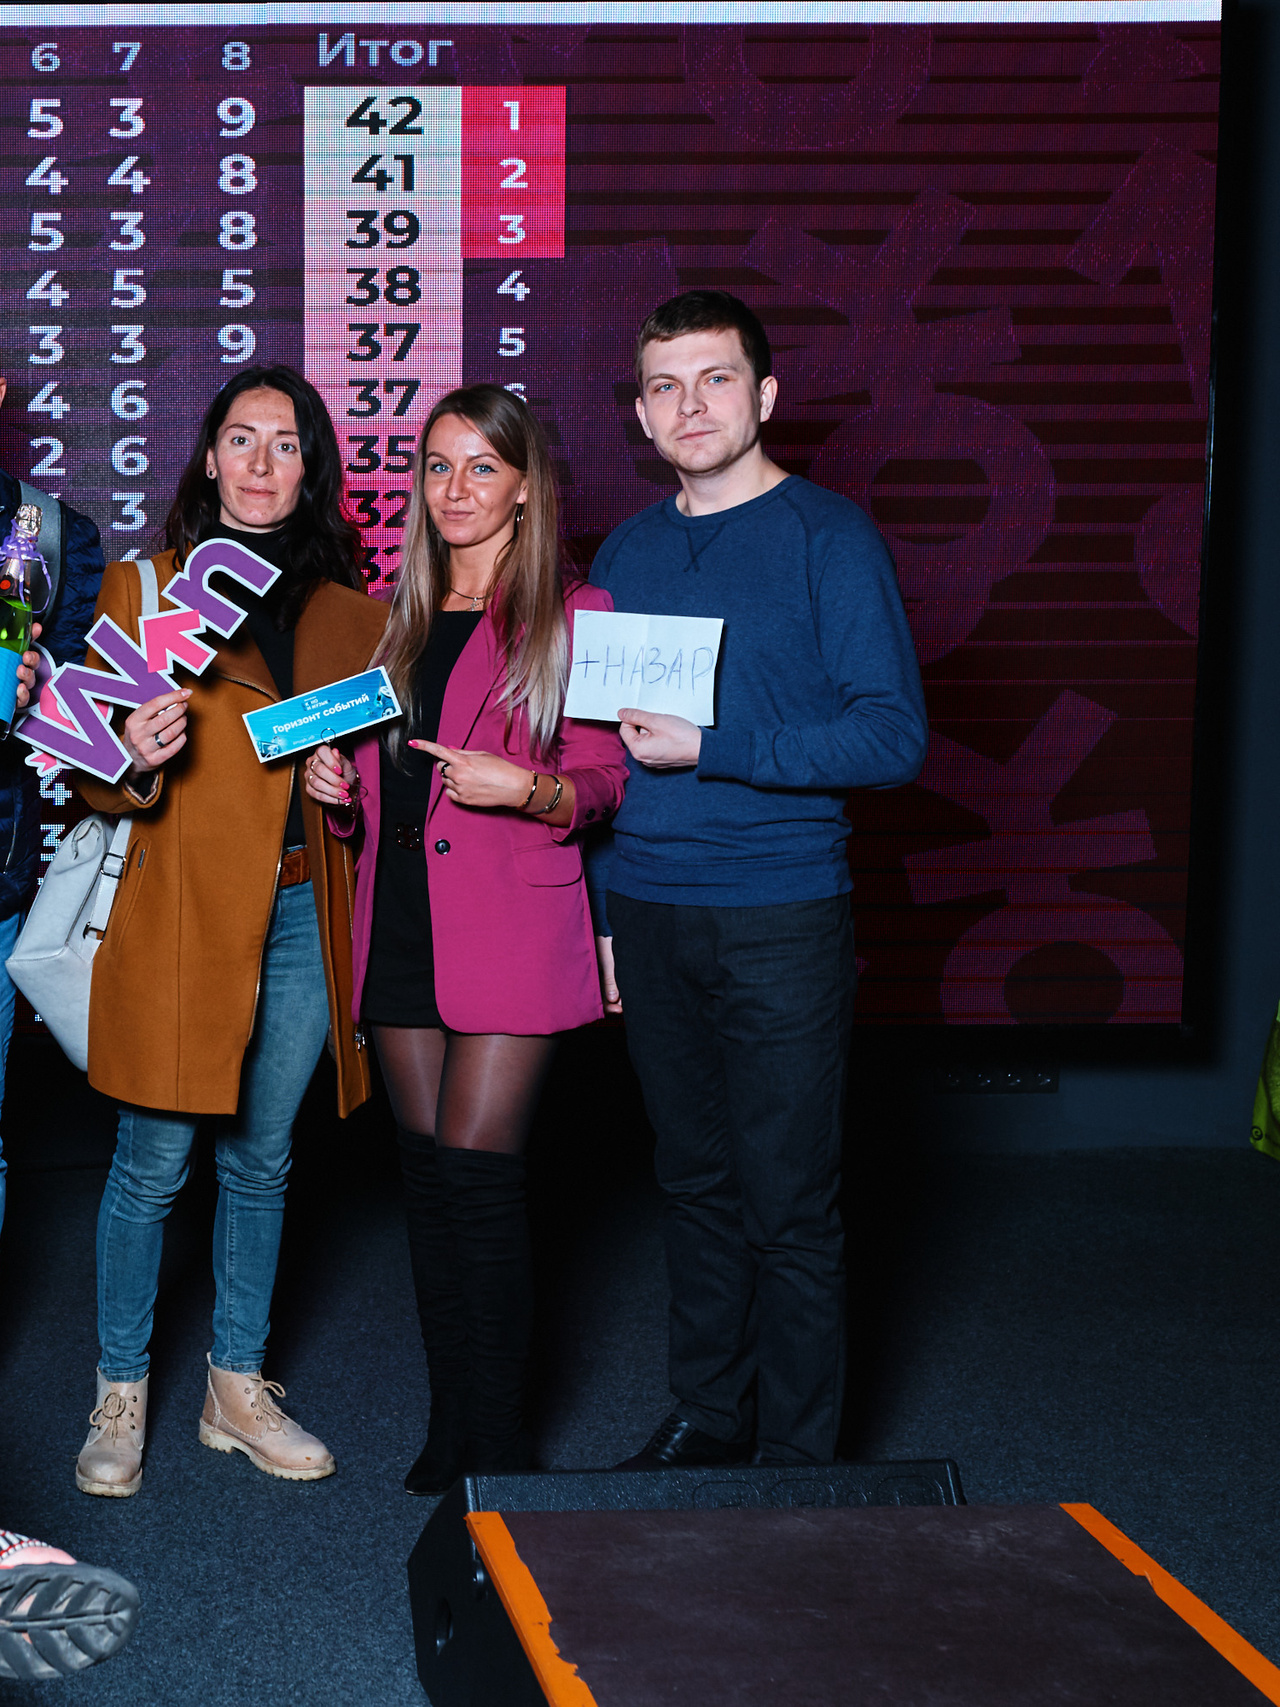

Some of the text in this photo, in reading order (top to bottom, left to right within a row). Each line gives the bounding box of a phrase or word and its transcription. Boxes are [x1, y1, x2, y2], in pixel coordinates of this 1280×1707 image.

[31, 42, 61, 72] 6
[113, 41, 142, 71] 7
[221, 41, 251, 71] 8
[319, 32, 453, 66] Итог
[27, 98, 64, 138] 5
[109, 98, 145, 138] 3
[216, 97, 256, 137] 9
[346, 95, 425, 136] 42
[503, 100, 520, 131] 1
[25, 156, 69, 194] 4
[107, 155, 151, 194] 4
[219, 154, 258, 195] 8
[351, 153, 415, 193] 41
[499, 158, 529, 189] 2
[28, 212, 65, 252] 5
[109, 211, 146, 251] 3
[219, 211, 257, 251] 8
[346, 209, 422, 249] 39
[498, 214, 526, 244] 3
[26, 270, 70, 307] 4
[111, 269, 147, 309] 5
[219, 269, 256, 308] 5
[346, 265, 422, 307] 38
[496, 270, 531, 301] 4
[29, 325, 65, 365] 3
[111, 324, 146, 364] 3
[218, 324, 256, 363] 9
[346, 322, 422, 362] 37
[498, 327, 525, 357] 5
[28, 382, 71, 420] 4
[111, 379, 150, 420] 6
[346, 378, 422, 418] 37
[30, 437, 66, 476] 2
[111, 436, 149, 476] 6
[347, 435, 416, 473] 35
[112, 492, 147, 531] 3
[272, 693, 370, 734] Горизонт событий
[35, 764, 72, 805] 4
